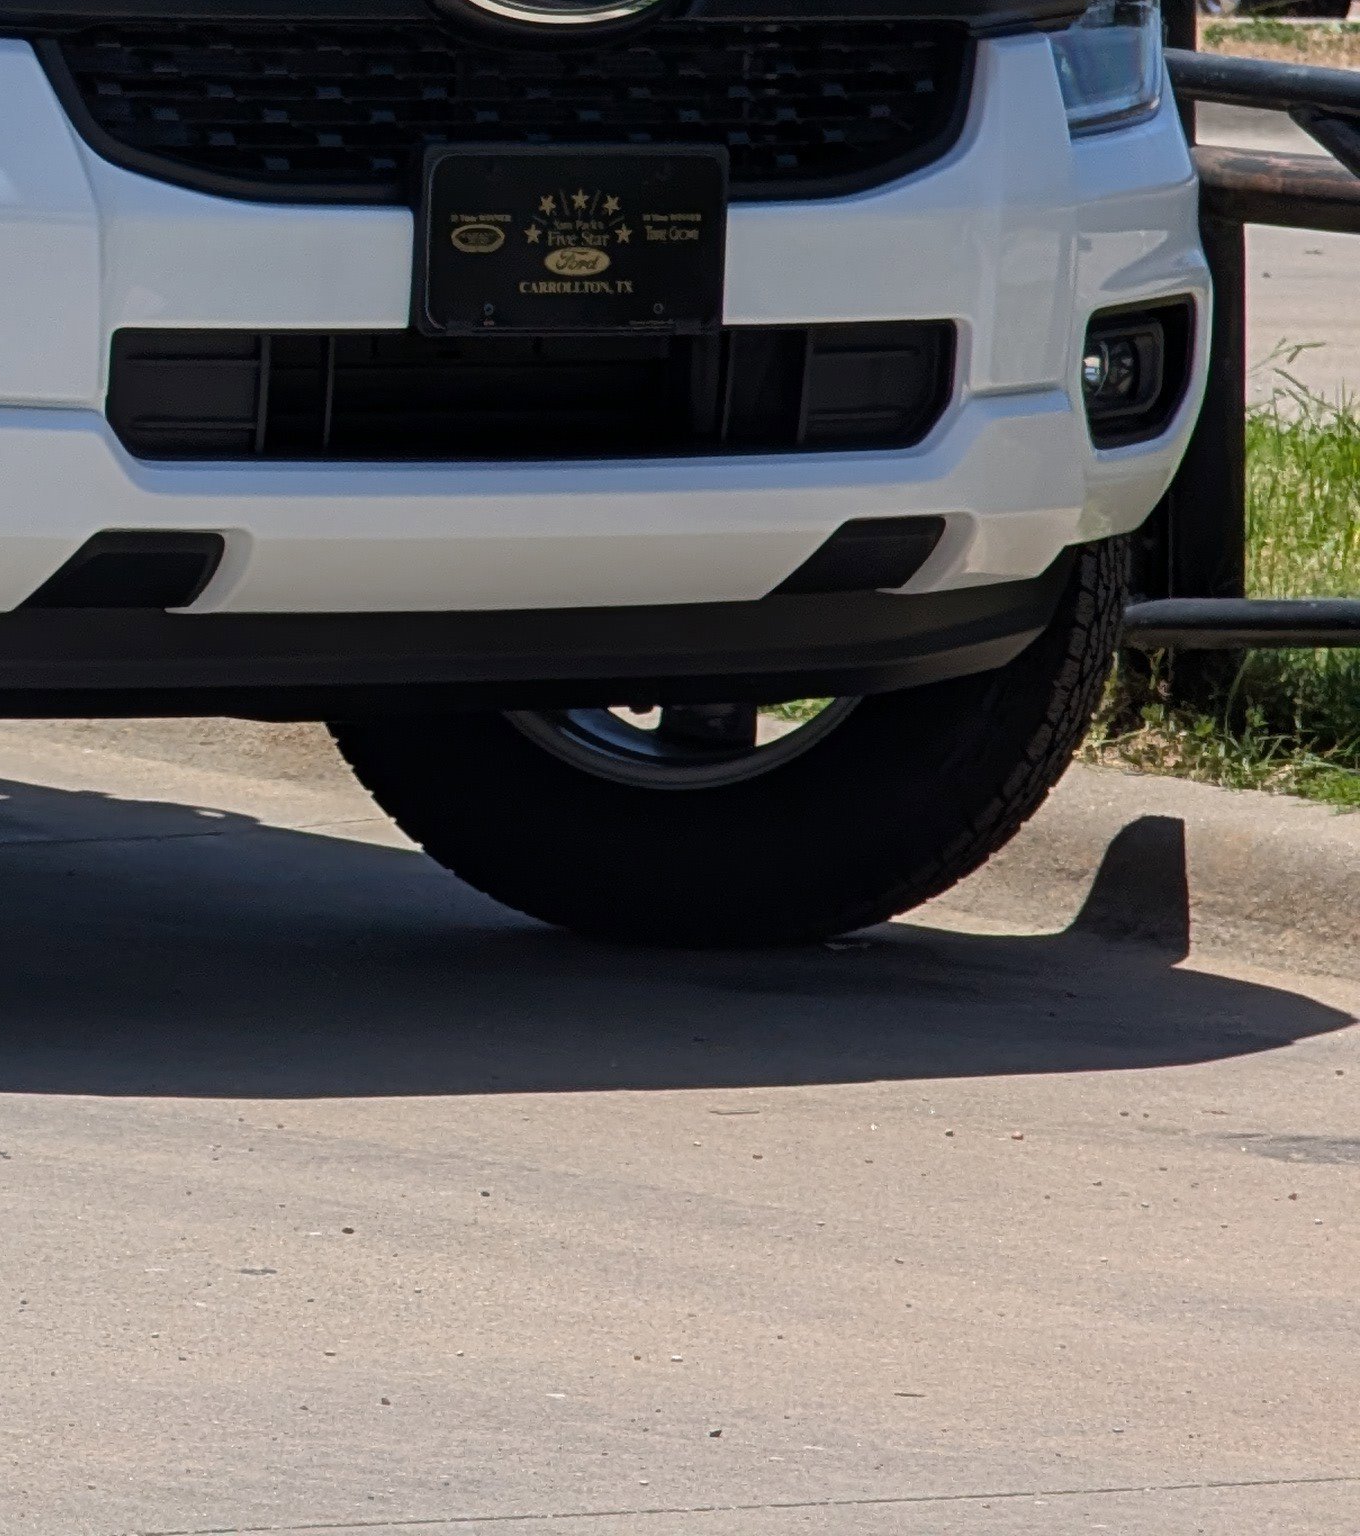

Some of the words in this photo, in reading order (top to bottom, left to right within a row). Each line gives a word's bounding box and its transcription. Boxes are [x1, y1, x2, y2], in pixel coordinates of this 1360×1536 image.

[547, 230, 577, 246] Five
[581, 230, 610, 246] Star
[555, 249, 601, 271] Ford
[616, 279, 635, 294] TX
